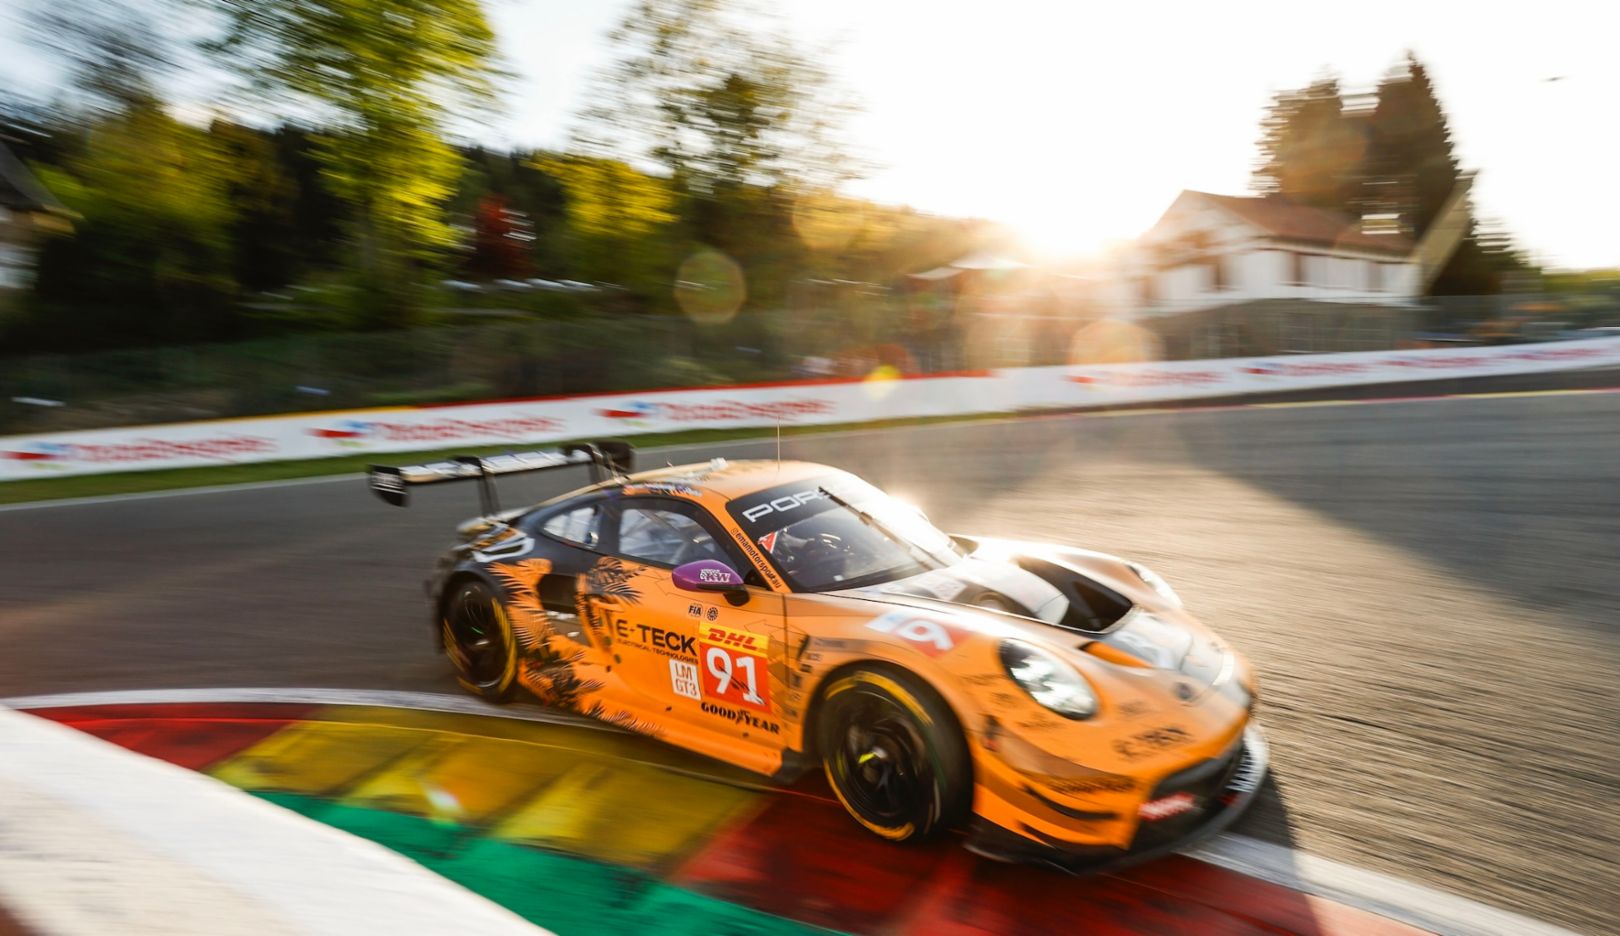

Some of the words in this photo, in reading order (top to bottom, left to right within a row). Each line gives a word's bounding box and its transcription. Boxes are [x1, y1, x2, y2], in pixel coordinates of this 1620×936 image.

[688, 604, 702, 615] FIA
[616, 618, 698, 657] E-TECK
[708, 628, 758, 651] DHL
[674, 662, 693, 681] LM
[706, 647, 767, 706] 91
[675, 678, 698, 697] GT3
[701, 701, 780, 735] GOODYEAR
